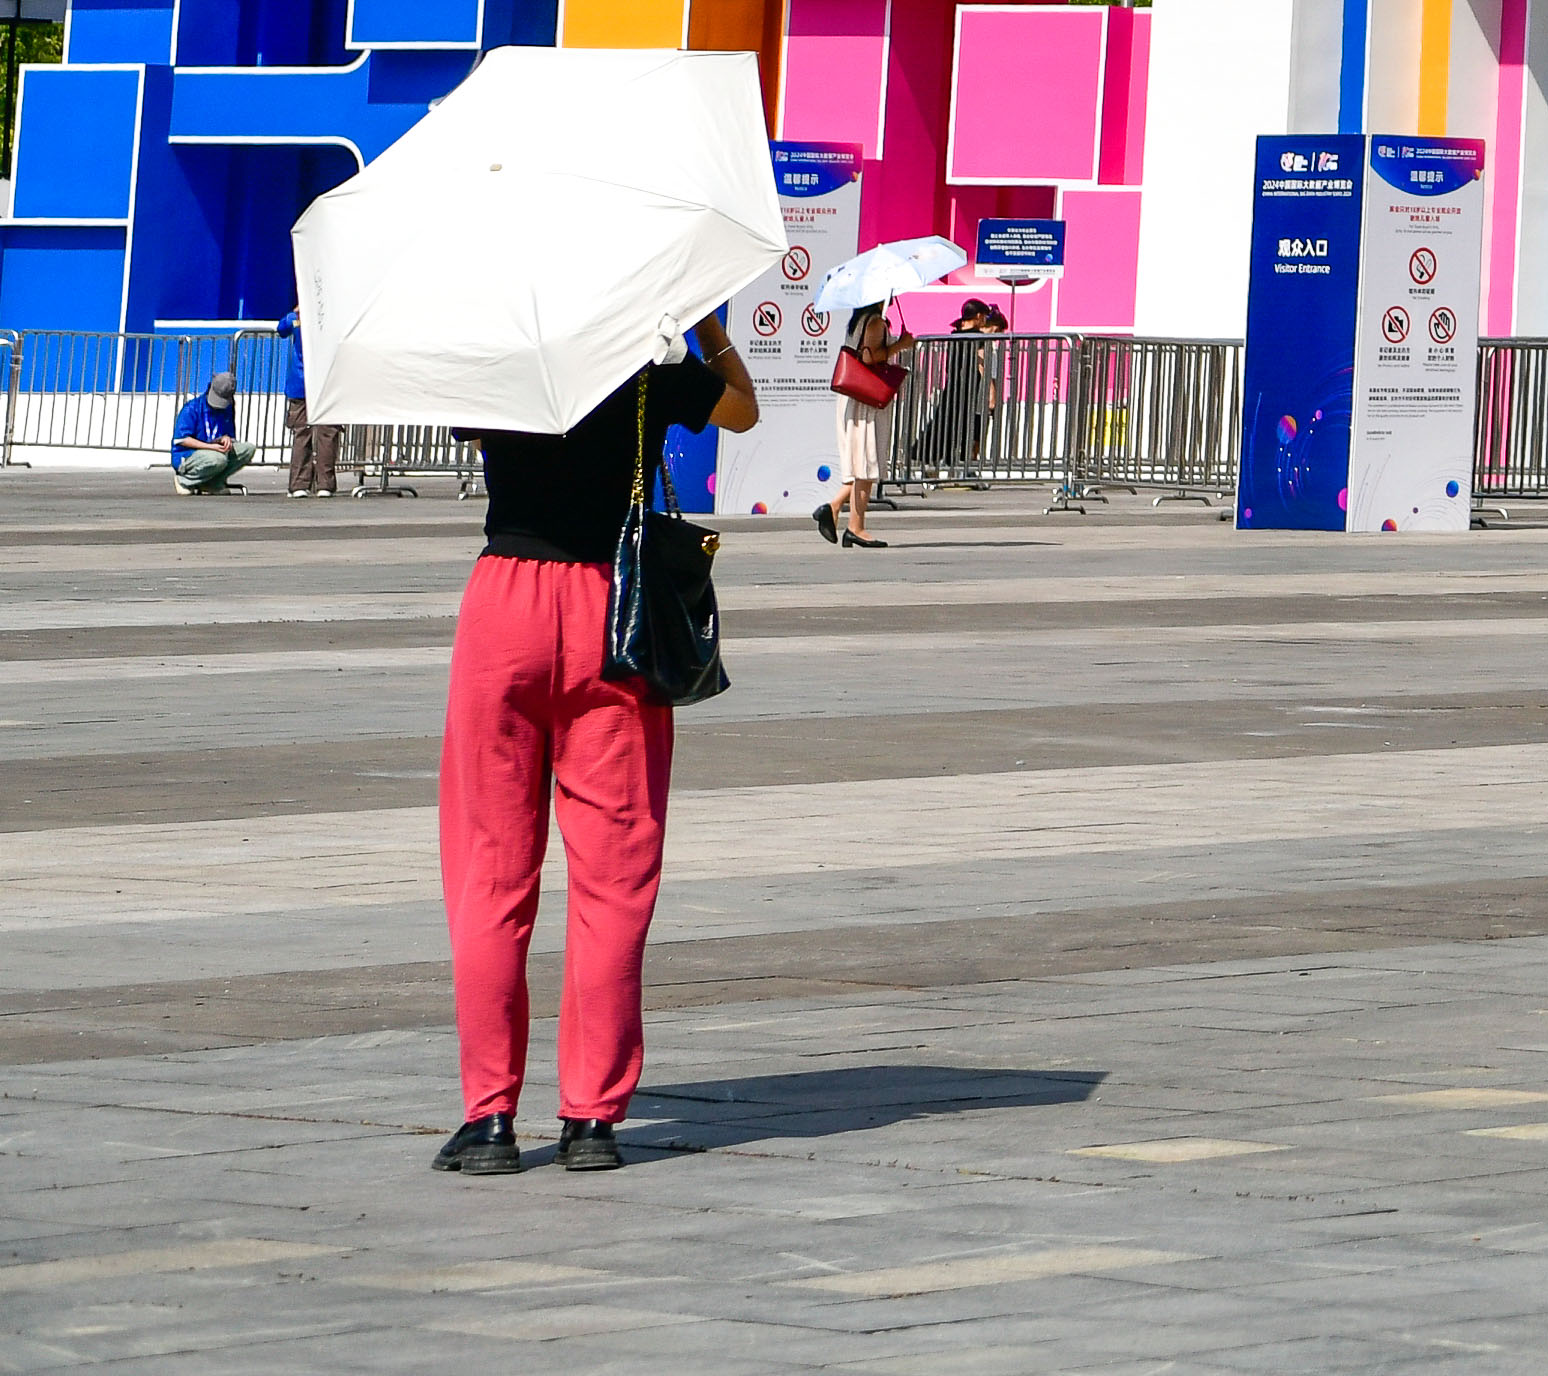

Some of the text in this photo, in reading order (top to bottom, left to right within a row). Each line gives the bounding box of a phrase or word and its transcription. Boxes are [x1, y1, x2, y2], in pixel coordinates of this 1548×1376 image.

[1278, 238, 1328, 257] 观众入口
[1274, 263, 1331, 275] Visitor Entrance
